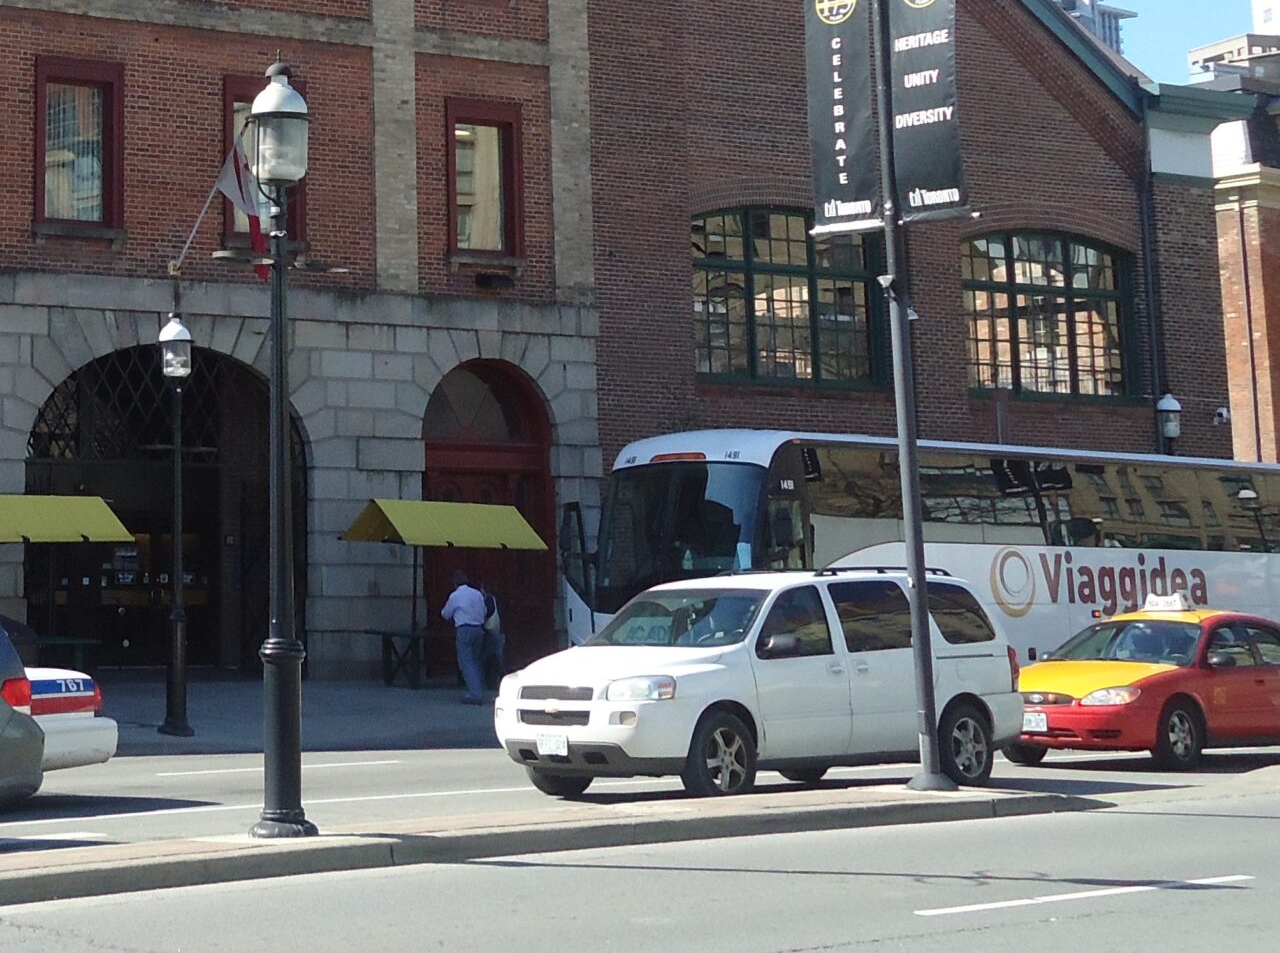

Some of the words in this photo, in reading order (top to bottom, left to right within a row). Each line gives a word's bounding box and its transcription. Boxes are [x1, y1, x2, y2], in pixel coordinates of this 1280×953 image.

[894, 28, 949, 52] HERITAGE
[904, 69, 939, 88] UNITY
[831, 37, 848, 185] CELEBRATE
[895, 107, 954, 129] DIVERSITY
[1039, 550, 1209, 616] Viaggidea
[56, 679, 85, 692] 767
